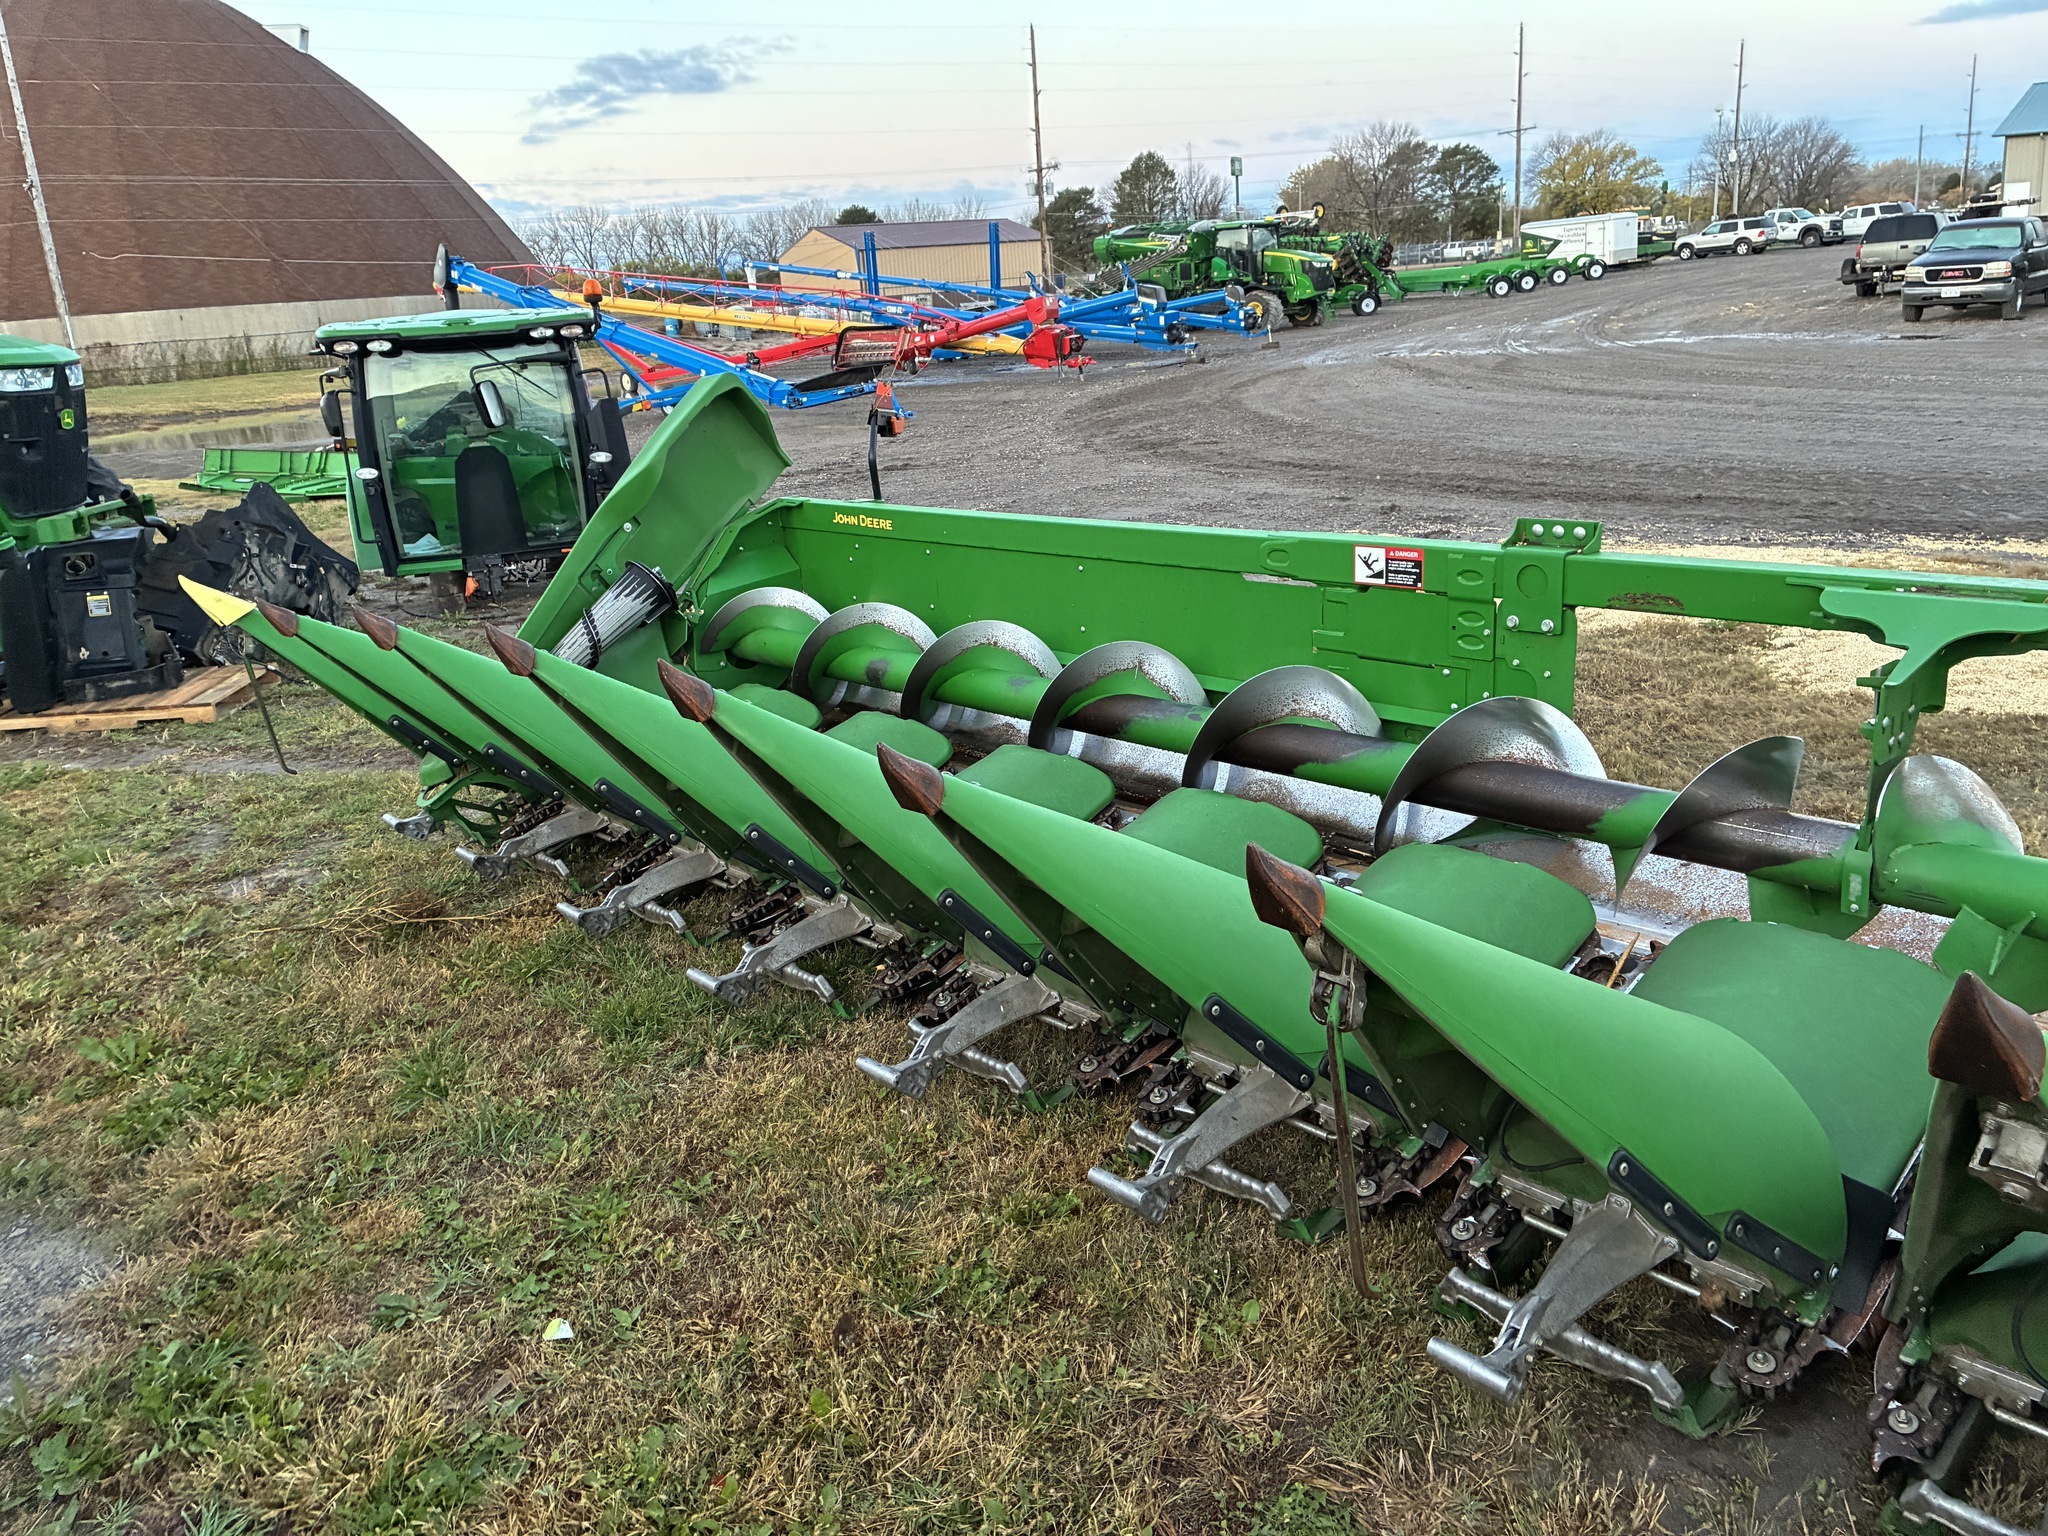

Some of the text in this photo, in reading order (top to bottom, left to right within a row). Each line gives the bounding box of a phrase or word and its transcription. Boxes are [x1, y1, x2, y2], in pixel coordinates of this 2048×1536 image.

[833, 511, 893, 530] JOHN DEERE
[1395, 550, 1419, 558] DANGER
